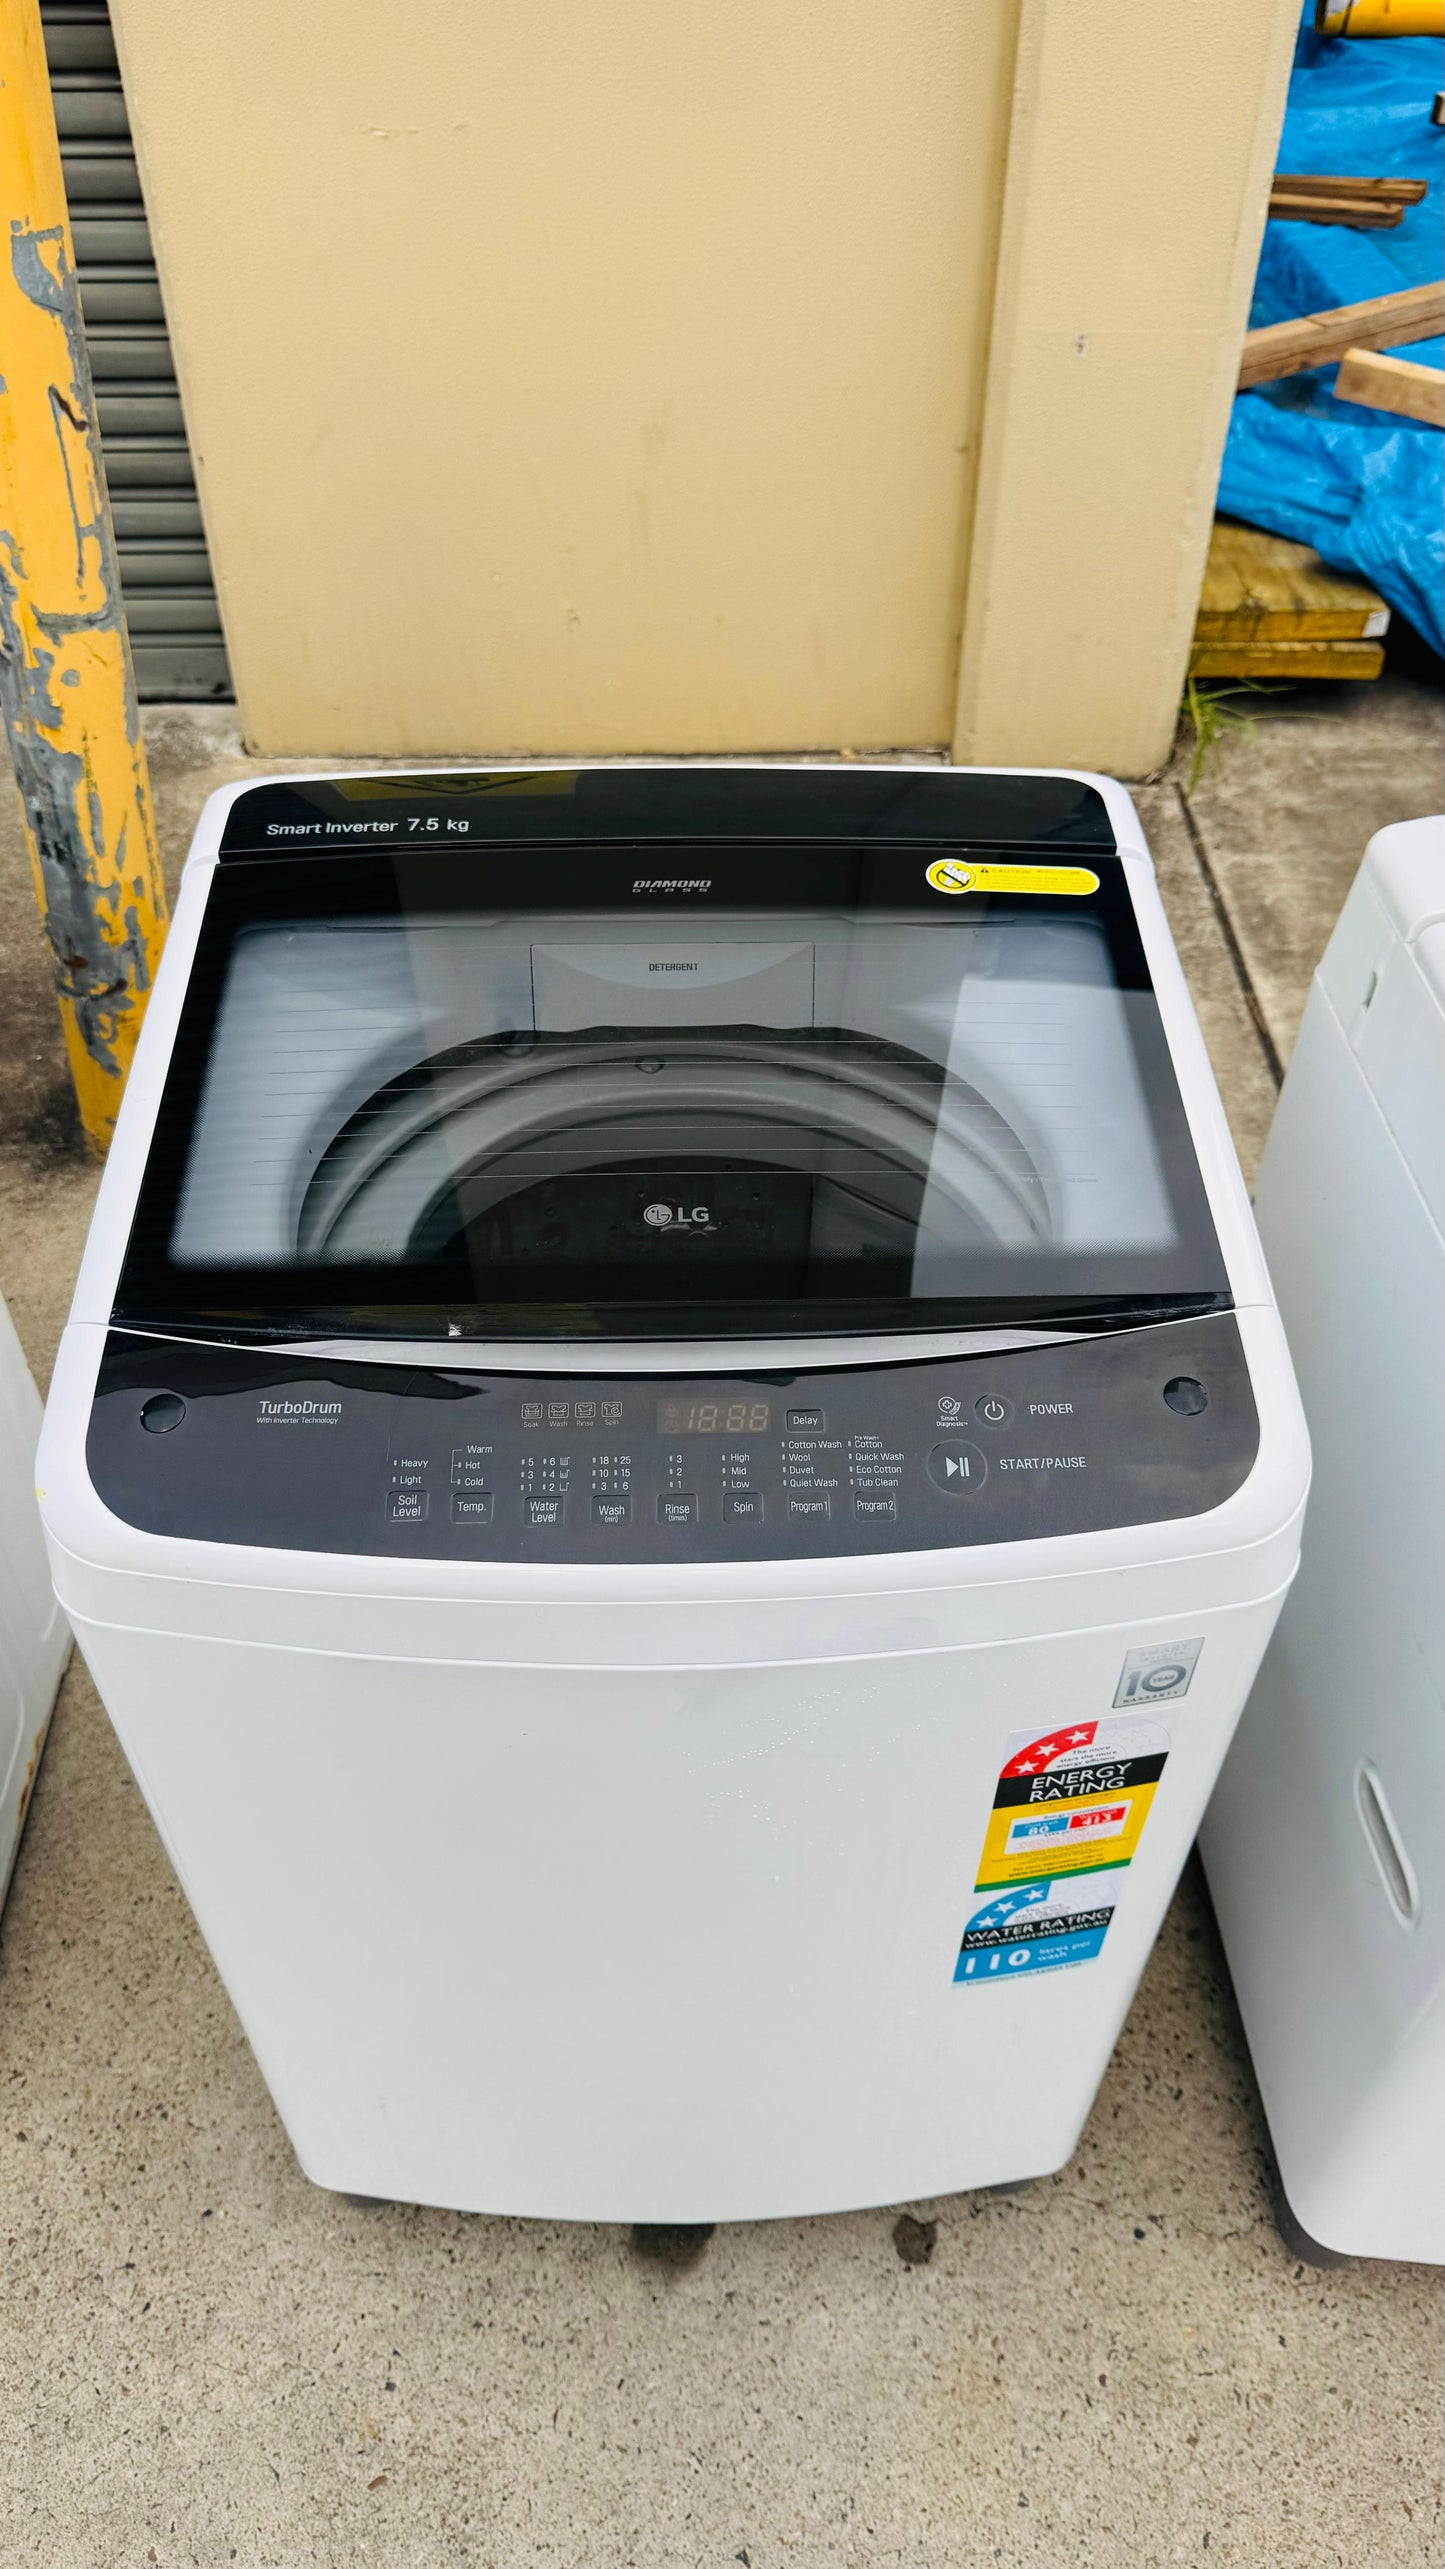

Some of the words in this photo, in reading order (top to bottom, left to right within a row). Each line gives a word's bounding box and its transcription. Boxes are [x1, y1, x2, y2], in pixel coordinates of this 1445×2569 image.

[266, 823, 323, 836] Smart
[325, 821, 399, 834] Inverter
[407, 817, 440, 832] 7.5
[447, 819, 470, 833] kg
[632, 880, 712, 889] DIAMOND
[648, 963, 699, 972] DETERGENT
[678, 1206, 709, 1223] LG
[260, 1400, 342, 1415] TurboDrum
[1029, 1403, 1074, 1416] POWER
[256, 1416, 273, 1424] With
[273, 1416, 300, 1424] Inverter
[301, 1416, 339, 1425] Technology
[549, 1420, 568, 1428] Wash
[792, 1416, 819, 1427] Delay
[467, 1445, 493, 1454] Warm
[788, 1440, 816, 1449] Cotton
[818, 1440, 843, 1449] Wash
[854, 1440, 883, 1449] Cotton
[600, 1456, 610, 1465] 18
[620, 1455, 632, 1465] 25
[676, 1455, 683, 1464] 3
[730, 1453, 750, 1464] High
[788, 1453, 811, 1462] Wool
[855, 1452, 879, 1462] Quick
[880, 1452, 905, 1461] Wash
[401, 1459, 429, 1469] Heavy
[465, 1461, 481, 1470] Hot
[528, 1458, 534, 1467] 5
[549, 1458, 556, 1466] 6
[1000, 1456, 1087, 1471] START/PAUSE
[599, 1469, 609, 1478] 10
[621, 1468, 631, 1478] 15
[676, 1467, 683, 1477] 2
[731, 1467, 747, 1476] Mid
[789, 1466, 814, 1475] Duvet
[856, 1465, 872, 1474] Eco
[873, 1465, 902, 1474] Cotton
[400, 1475, 422, 1485] Light
[527, 1471, 534, 1480] 3
[549, 1470, 555, 1478] 4
[464, 1477, 484, 1486] Cold
[601, 1482, 607, 1491] 3
[622, 1481, 629, 1490] 6
[731, 1480, 750, 1489] Low
[789, 1478, 812, 1488] Quiet
[814, 1478, 838, 1487] Wash
[857, 1478, 873, 1487] Tub
[875, 1478, 899, 1487] Clean
[549, 1483, 555, 1492] 2
[398, 1494, 418, 1505] Soil
[457, 1501, 487, 1513] Temp.
[530, 1501, 559, 1511] Water
[598, 1505, 626, 1516] Wash
[665, 1503, 690, 1514] Rinse
[733, 1502, 754, 1514] Spin
[392, 1506, 421, 1517] Level
[531, 1512, 556, 1523] Level
[1126, 1664, 1187, 1697] 10
[1031, 1762, 1133, 1790] ENERGY
[1029, 1777, 1126, 1803] RATING
[966, 1924, 1035, 1943] WATER
[1039, 1908, 1112, 1931] RATING
